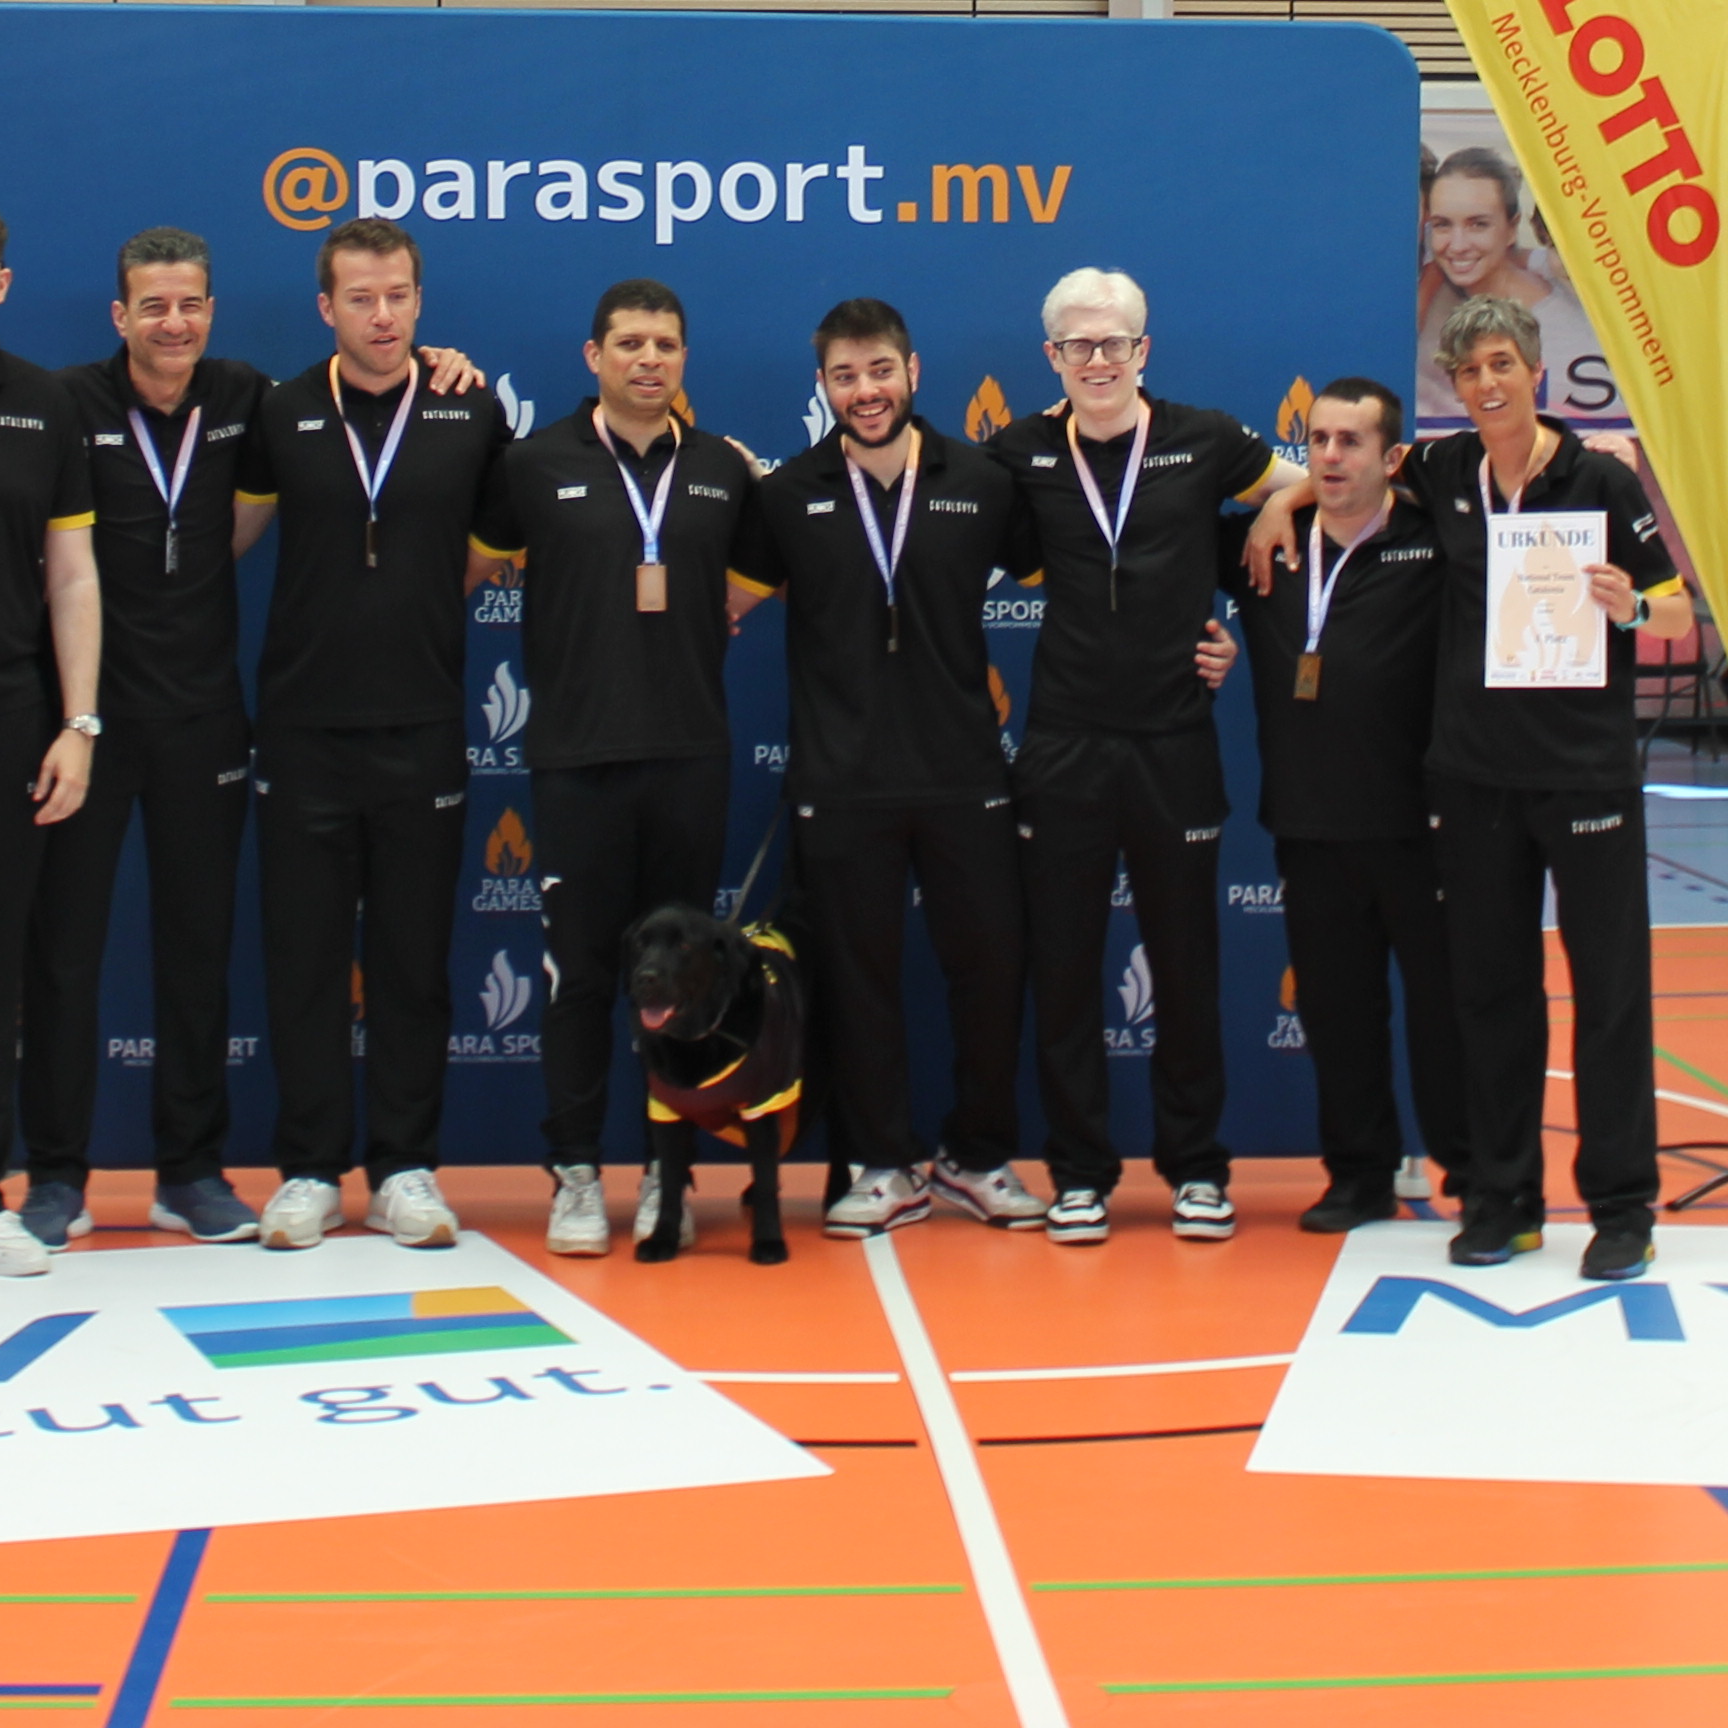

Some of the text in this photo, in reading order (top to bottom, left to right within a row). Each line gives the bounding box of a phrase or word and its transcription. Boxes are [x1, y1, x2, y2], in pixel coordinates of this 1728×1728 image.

[262, 144, 1073, 246] @parasport.mv
[1491, 13, 1674, 387] Mecklenburg-Vorpommern
[1497, 528, 1595, 549] URKUNDE
[483, 590, 522, 607] PAR
[982, 601, 1045, 621] SPOR
[481, 879, 534, 896] PARA
[448, 1035, 495, 1055] ARA
[297, 1362, 674, 1424] gut.
